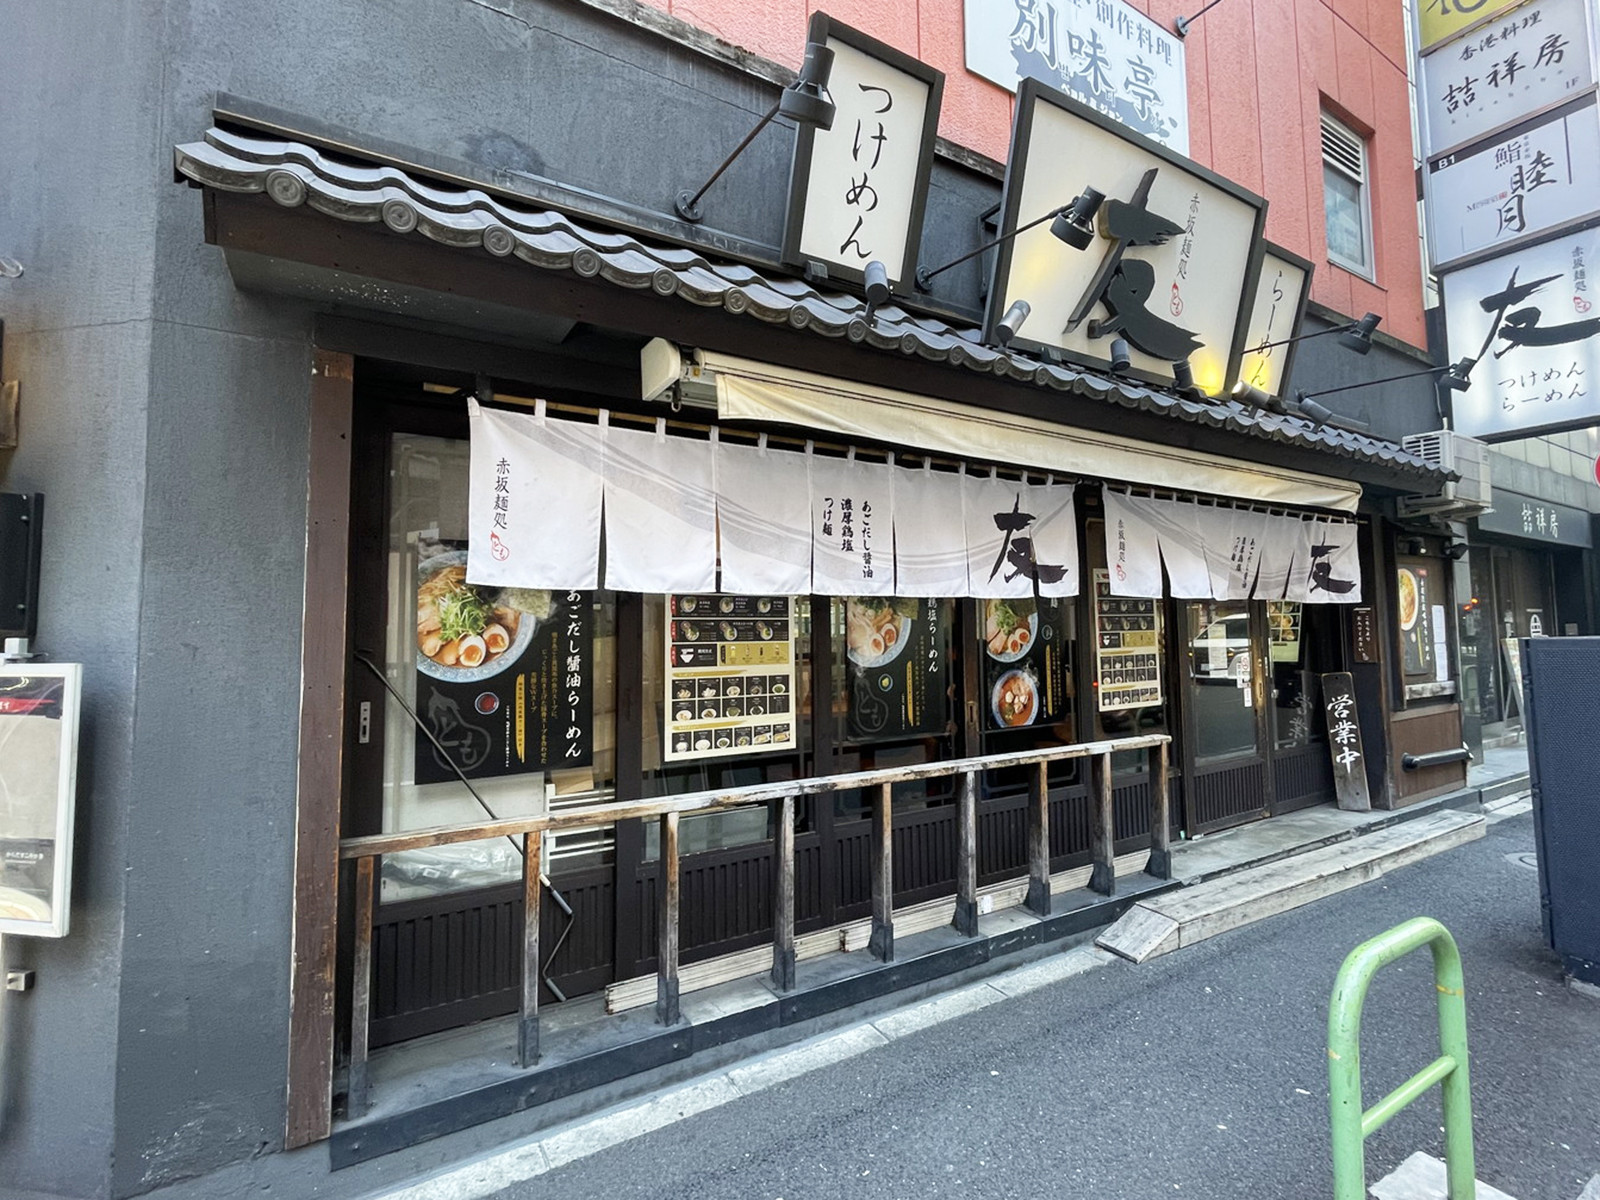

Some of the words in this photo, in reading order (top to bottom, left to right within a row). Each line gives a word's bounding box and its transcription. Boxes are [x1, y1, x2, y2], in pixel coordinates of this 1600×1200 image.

[1459, 10, 1543, 61] 香港料理
[1566, 76, 1580, 90] 1F
[840, 83, 893, 259] つけめん
[1438, 154, 1456, 170] B1
[1495, 141, 1521, 169] 鮨
[1496, 150, 1557, 237] 睦月
[1063, 168, 1206, 361] 友
[1250, 270, 1283, 386] らーめん
[1466, 265, 1600, 372] 友
[1498, 362, 1585, 388] つけめん
[1503, 384, 1587, 412] らーめん
[493, 457, 511, 530] 赤坂麺処
[823, 497, 834, 537] つけ麺
[841, 497, 854, 553] 濃厚鶏塩
[862, 500, 873, 578] あごだし醤油
[988, 492, 1069, 585] 友
[565, 589, 582, 758] あごだし醤油らーめん
[1326, 693, 1361, 774] 営業中
